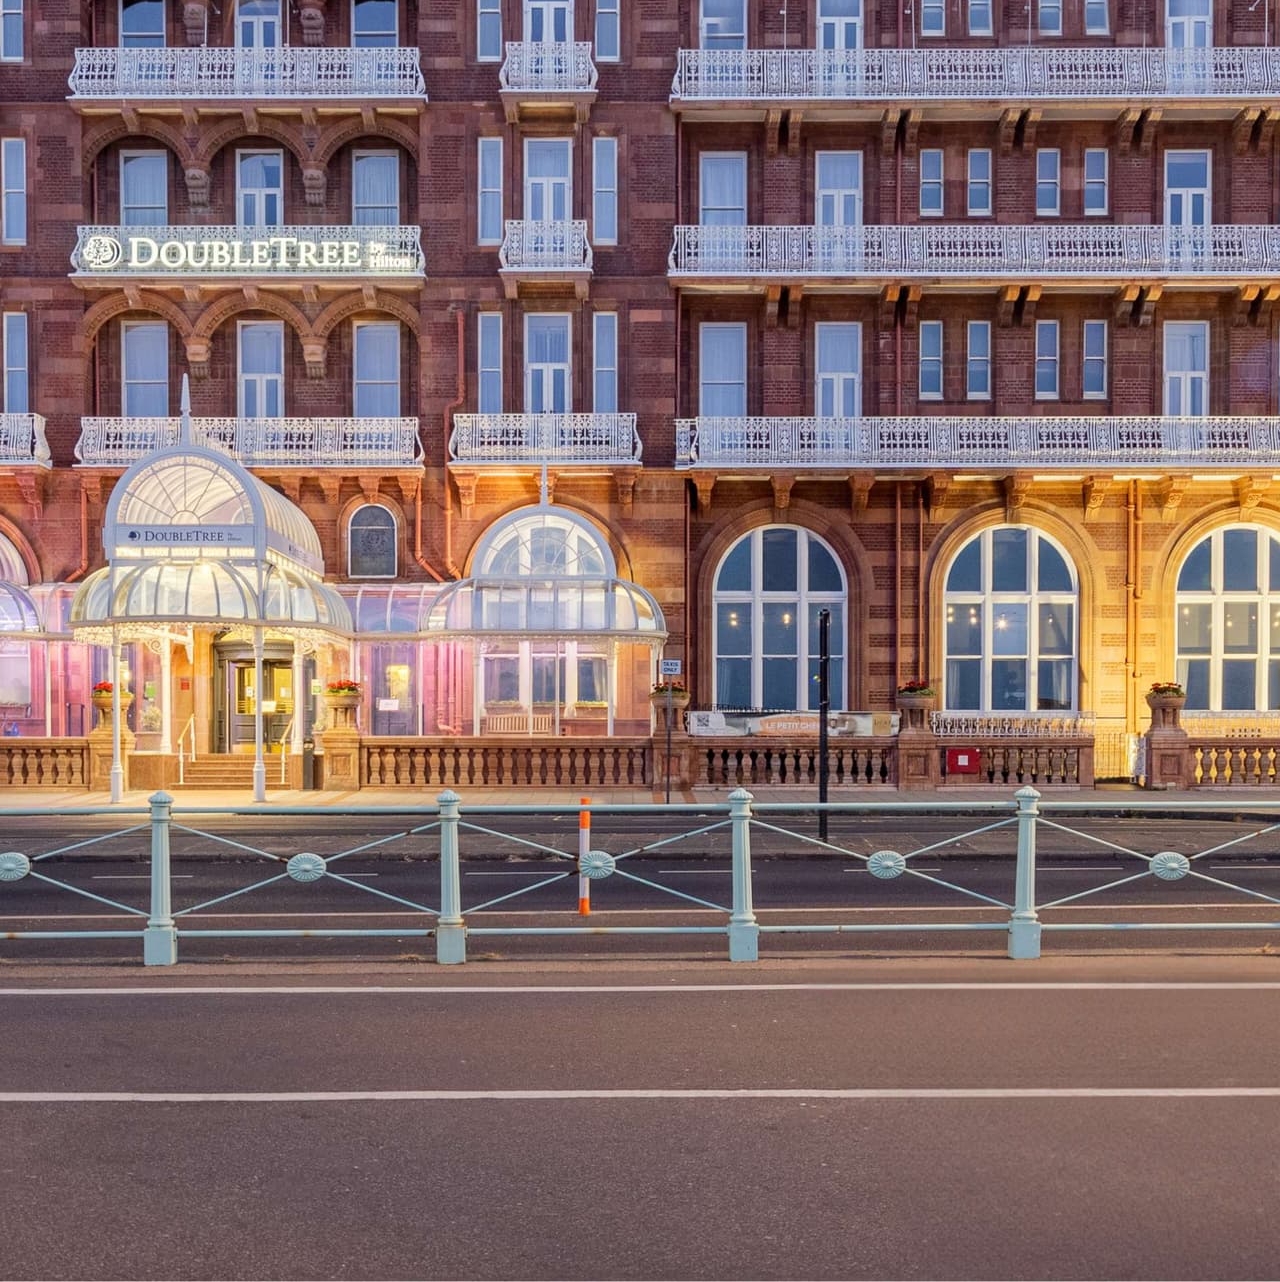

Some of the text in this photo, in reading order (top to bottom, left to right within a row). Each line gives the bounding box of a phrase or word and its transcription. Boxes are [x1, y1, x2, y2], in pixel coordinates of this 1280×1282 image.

[370, 240, 386, 256] by
[369, 254, 411, 268] Hilton
[777, 721, 799, 729] PETIT
